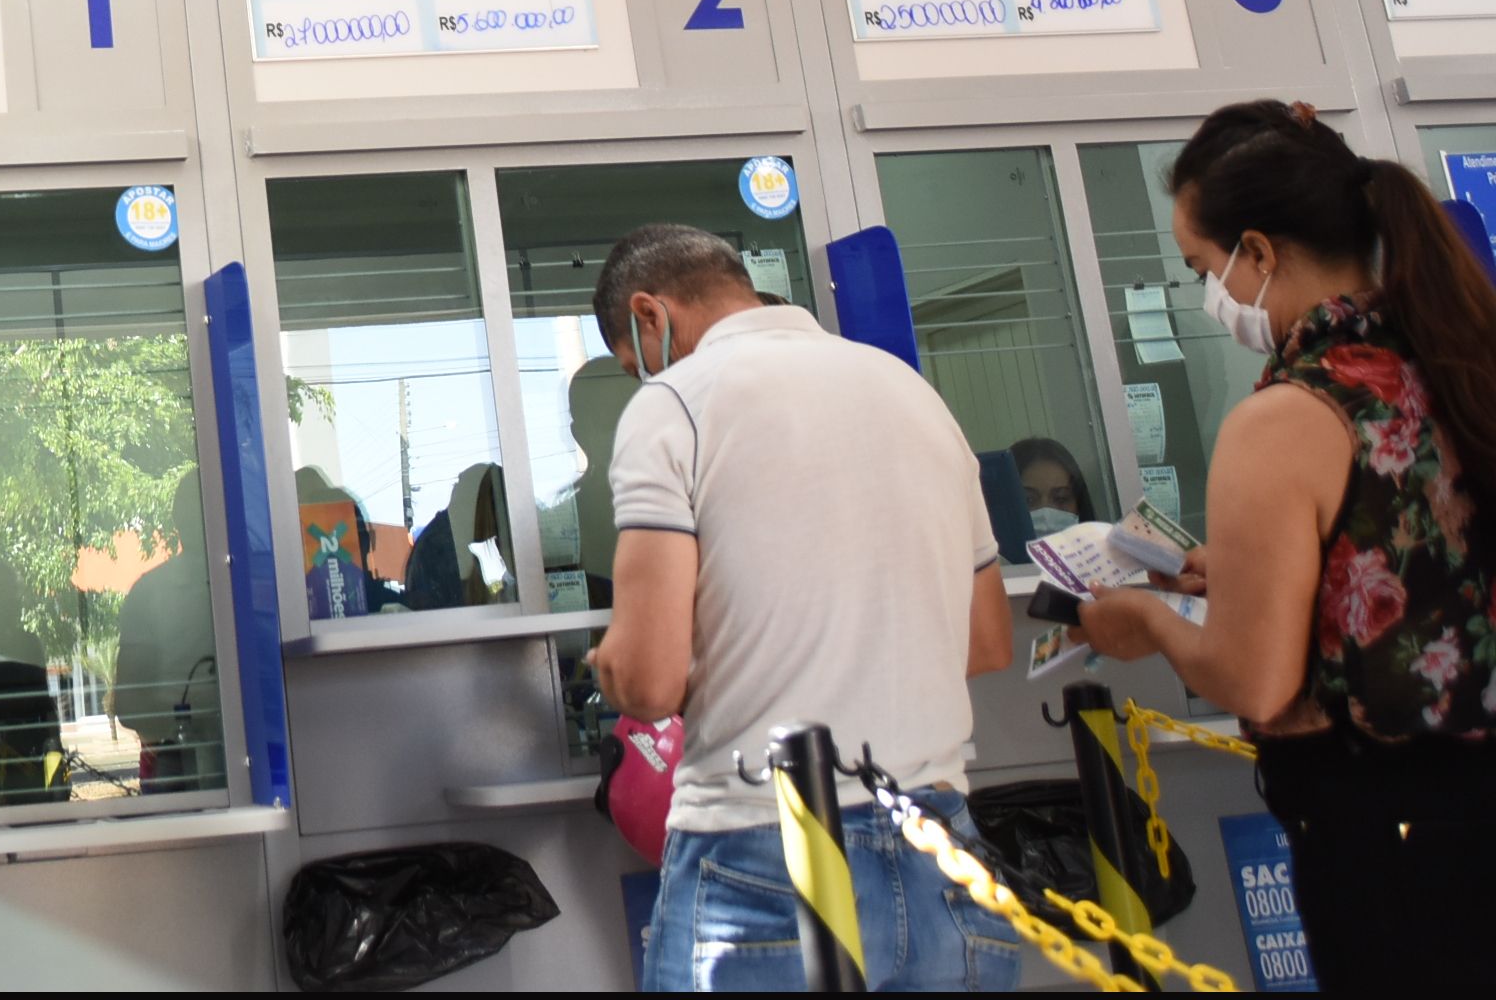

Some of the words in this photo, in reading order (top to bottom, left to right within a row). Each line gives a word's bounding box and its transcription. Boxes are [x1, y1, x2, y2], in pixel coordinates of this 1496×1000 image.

[865, 11, 882, 26] R$
[1018, 6, 1035, 21] R$
[266, 23, 285, 38] R$
[439, 15, 457, 32] R$
[122, 186, 175, 205] APOSTAR
[131, 200, 168, 220] 18+
[1241, 862, 1290, 888] SAC
[1245, 887, 1295, 918] 0800
[1256, 930, 1307, 950] CAIXA
[1260, 949, 1308, 980] 0800
